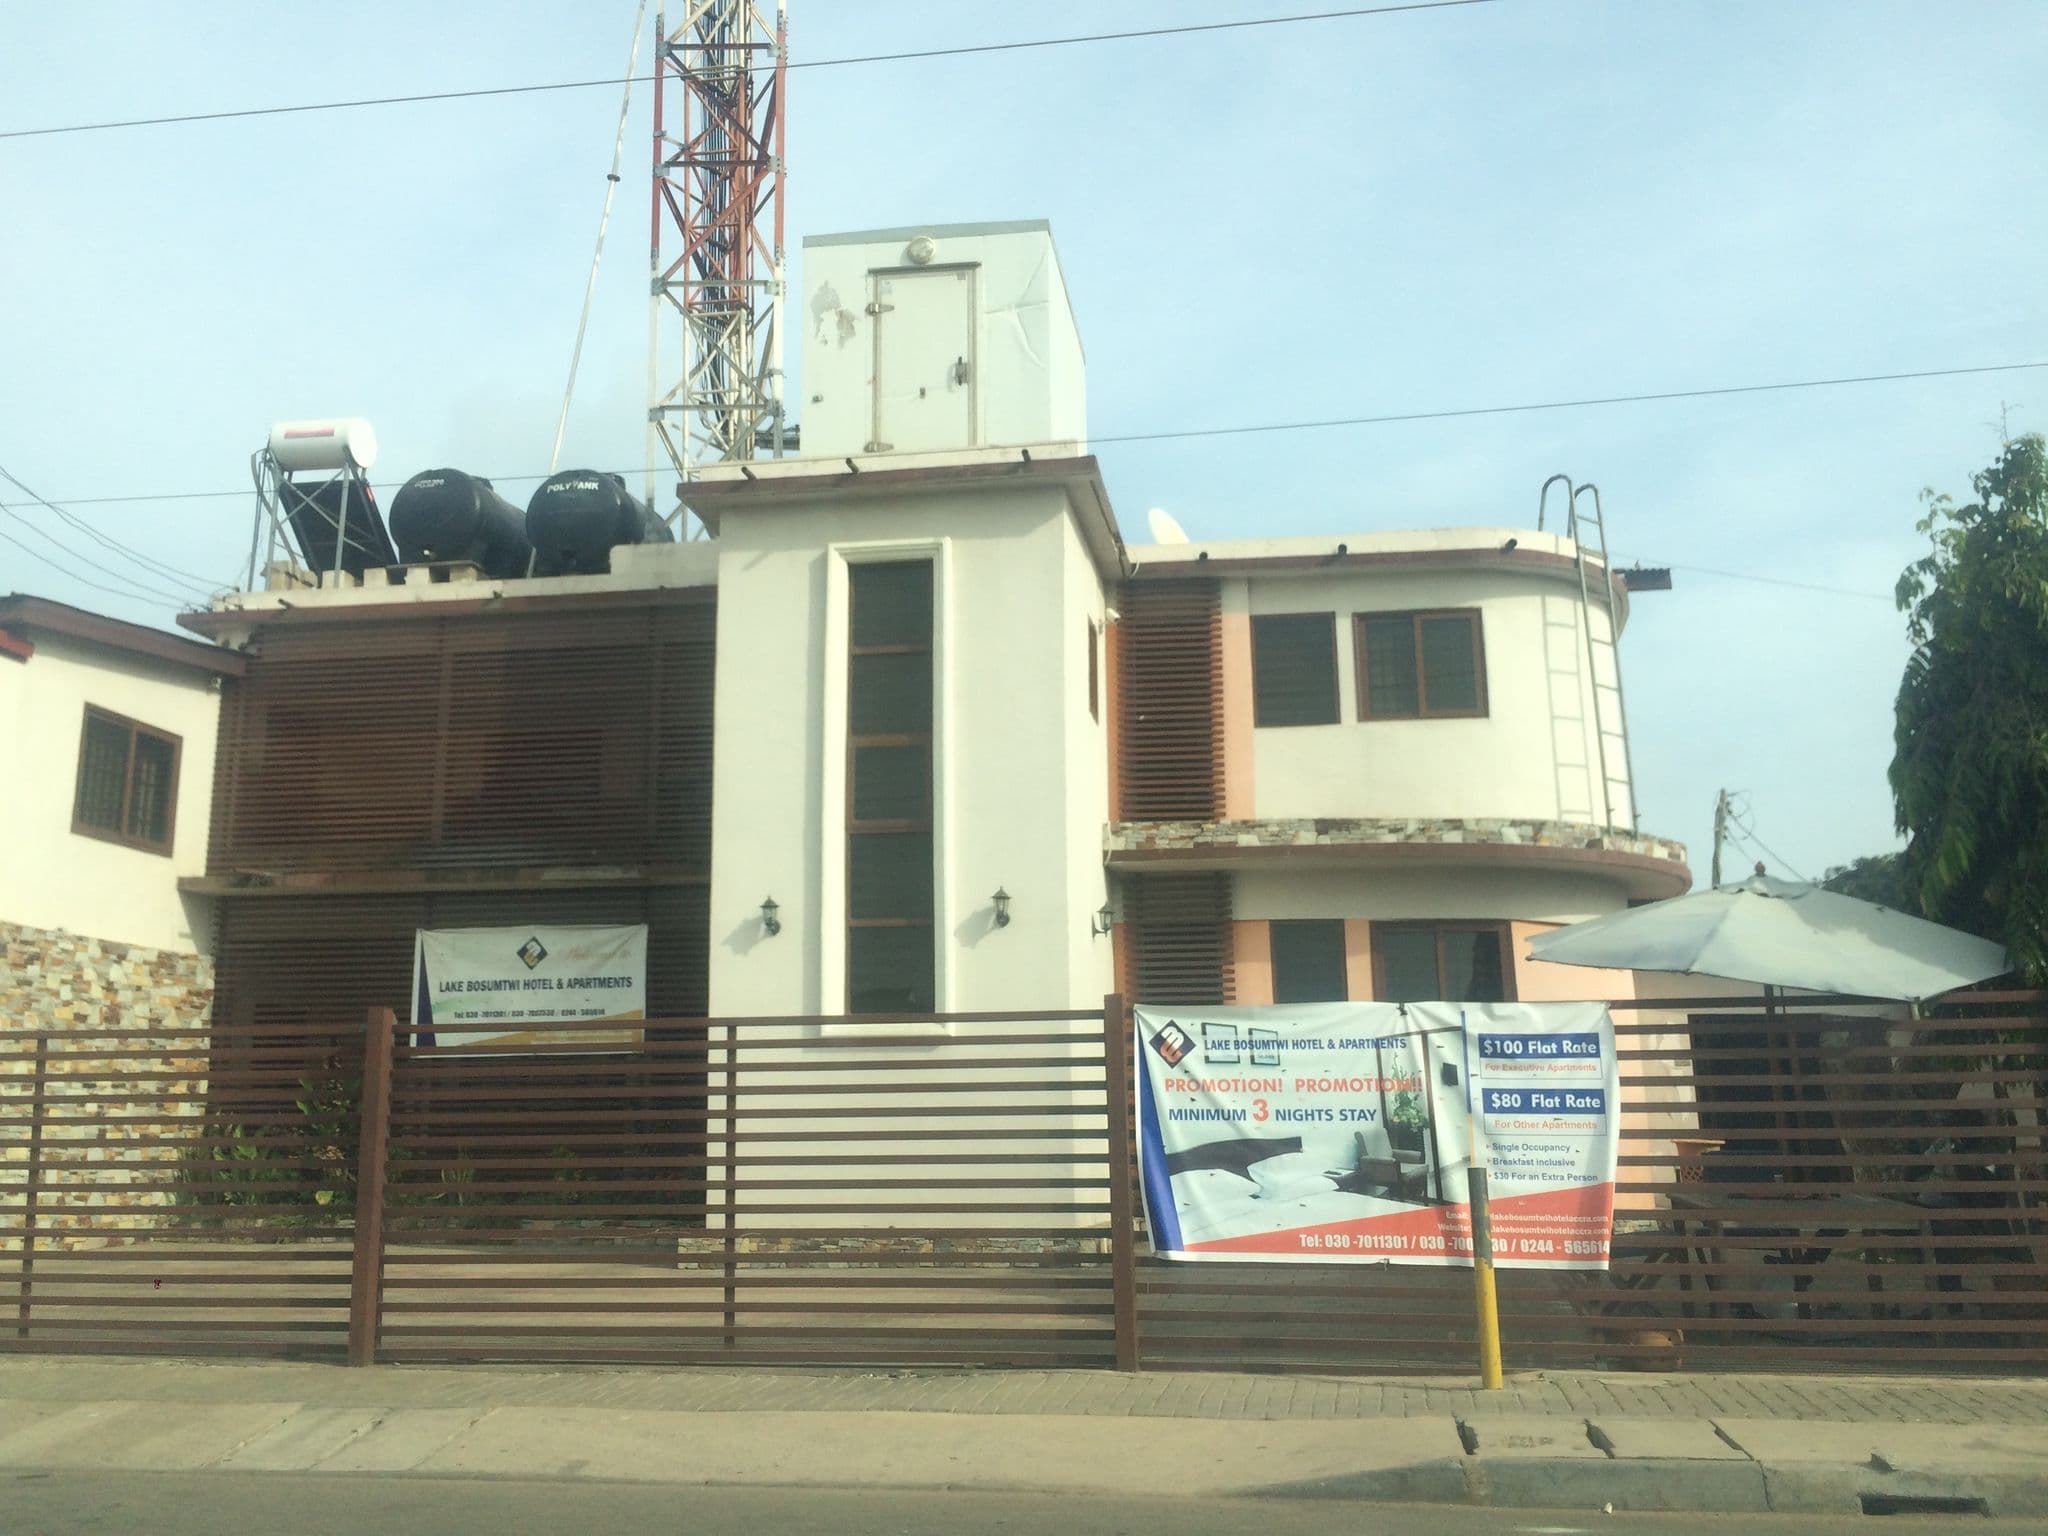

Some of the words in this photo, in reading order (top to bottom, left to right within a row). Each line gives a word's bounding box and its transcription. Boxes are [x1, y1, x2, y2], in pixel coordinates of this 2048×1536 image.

[439, 981, 464, 993] LAKE
[466, 980, 520, 992] BOSUMTWI
[523, 979, 554, 991] HOTEL
[557, 978, 563, 990] &
[566, 976, 632, 990] APARTMENTS
[1205, 1040, 1230, 1050] LAKE
[1234, 1040, 1288, 1050] BOSUMTWI
[1292, 1039, 1324, 1050] HOTEL
[1328, 1039, 1336, 1049] &
[1338, 1038, 1407, 1050] APARTMENTS
[1484, 1038, 1522, 1055] $100
[1528, 1040, 1557, 1054] Flat
[1562, 1040, 1596, 1054] Rate
[1485, 1064, 1498, 1072] For
[1502, 1063, 1544, 1072] Executive
[1547, 1063, 1596, 1073] Apartments
[1165, 1078, 1282, 1093] PROMOTION!
[1492, 1092, 1520, 1109] $80
[1532, 1094, 1560, 1108] Flat
[1566, 1094, 1600, 1108] Rate
[1169, 1108, 1246, 1121] MINIMUM
[1252, 1098, 1269, 1122] 3
[1275, 1108, 1334, 1122] NIGHTS
[1340, 1108, 1376, 1122] STAY
[1495, 1120, 1510, 1128] For
[1513, 1120, 1540, 1128] Other
[1542, 1120, 1598, 1130] Apartments
[1492, 1143, 1520, 1152] Single
[1522, 1144, 1570, 1153] Occupancy
[1492, 1158, 1534, 1166] Breakfast
[1494, 1172, 1509, 1180] $30
[1512, 1172, 1526, 1180] For
[1542, 1172, 1564, 1181] Extra
[1567, 1173, 1598, 1182] Person
[1300, 1234, 1322, 1248] Tel:
[1325, 1234, 1350, 1248] 030
[1411, 1235, 1416, 1250] /
[1420, 1236, 1445, 1250] 030
[1510, 1238, 1517, 1252] /
[1520, 1238, 1554, 1254] 0244
[1564, 1240, 1610, 1254] 565614
